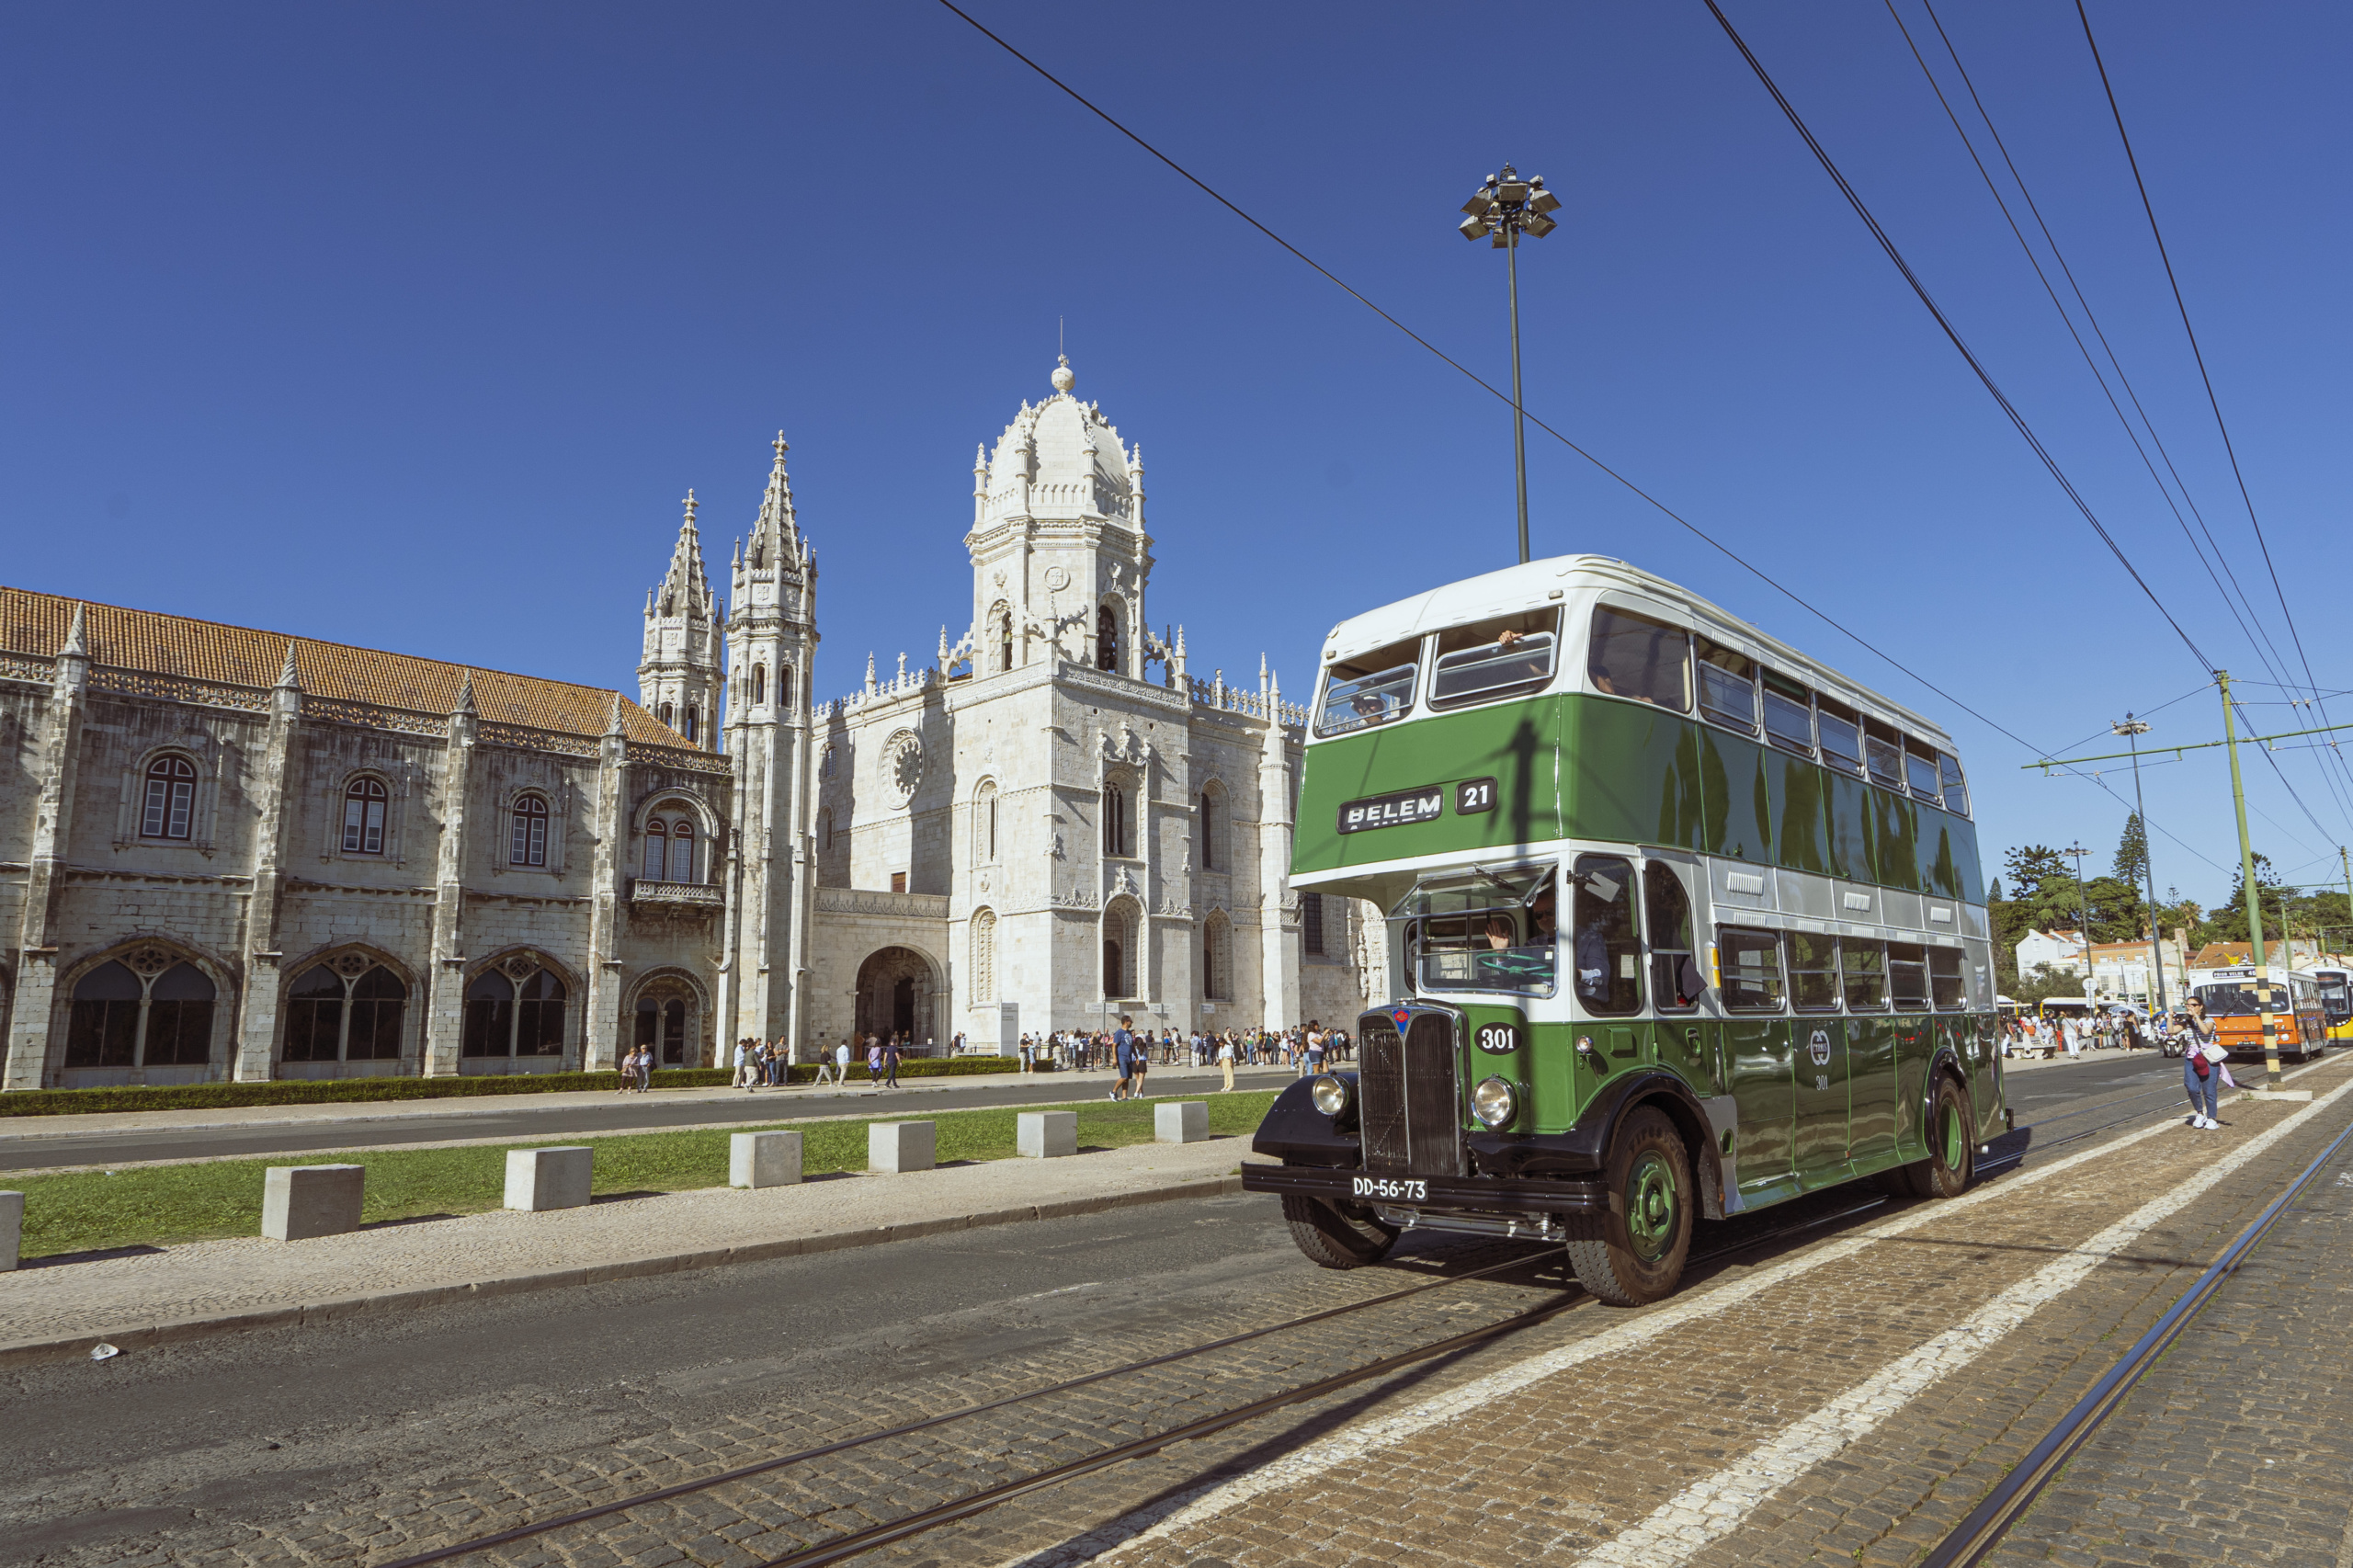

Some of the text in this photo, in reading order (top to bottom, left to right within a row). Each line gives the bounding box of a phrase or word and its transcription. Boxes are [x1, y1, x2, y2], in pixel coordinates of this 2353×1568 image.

[1464, 785, 1488, 807] 21
[1347, 795, 1441, 824] BELEM
[1481, 1028, 1514, 1050] 301
[1816, 1074, 1828, 1091] 301
[1353, 1177, 1426, 1199] DD-56-73
